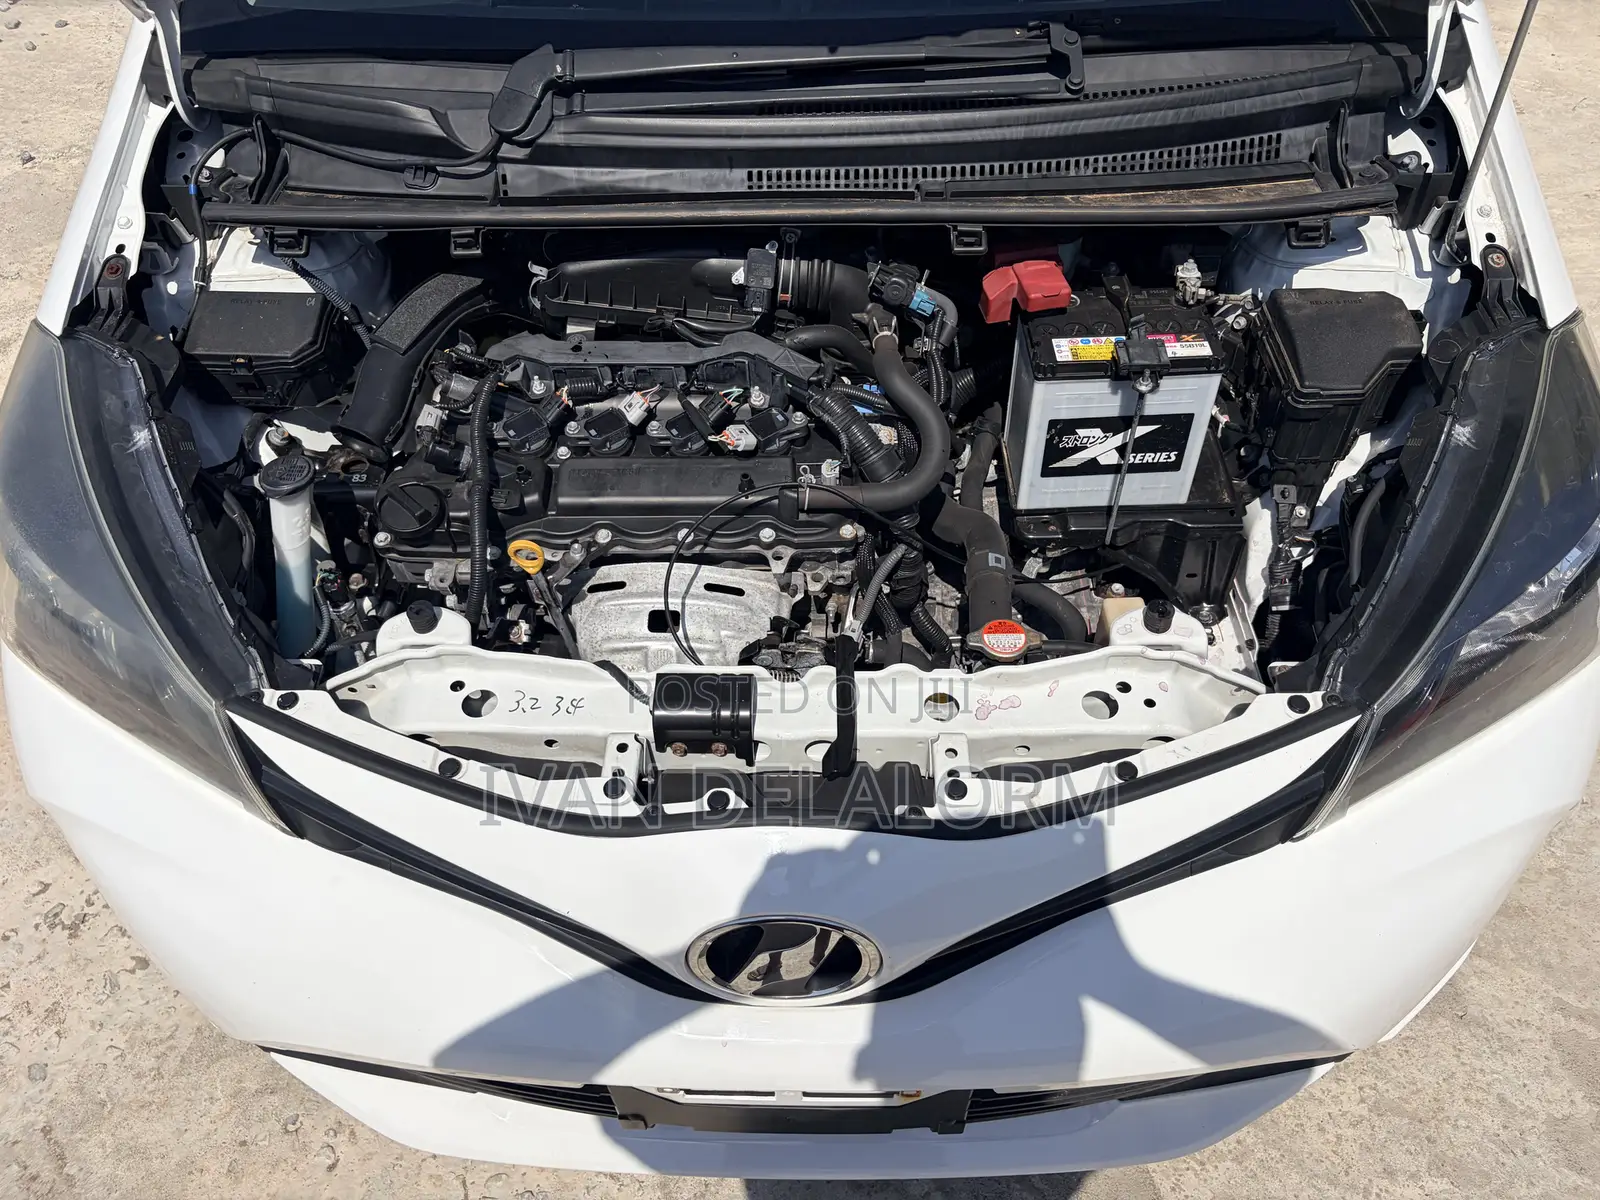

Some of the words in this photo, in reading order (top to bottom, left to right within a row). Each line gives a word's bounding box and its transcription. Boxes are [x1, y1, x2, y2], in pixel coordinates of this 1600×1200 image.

[1059, 432, 1113, 448] ストロング
[1127, 451, 1178, 464] SERIES
[351, 474, 367, 482] 83
